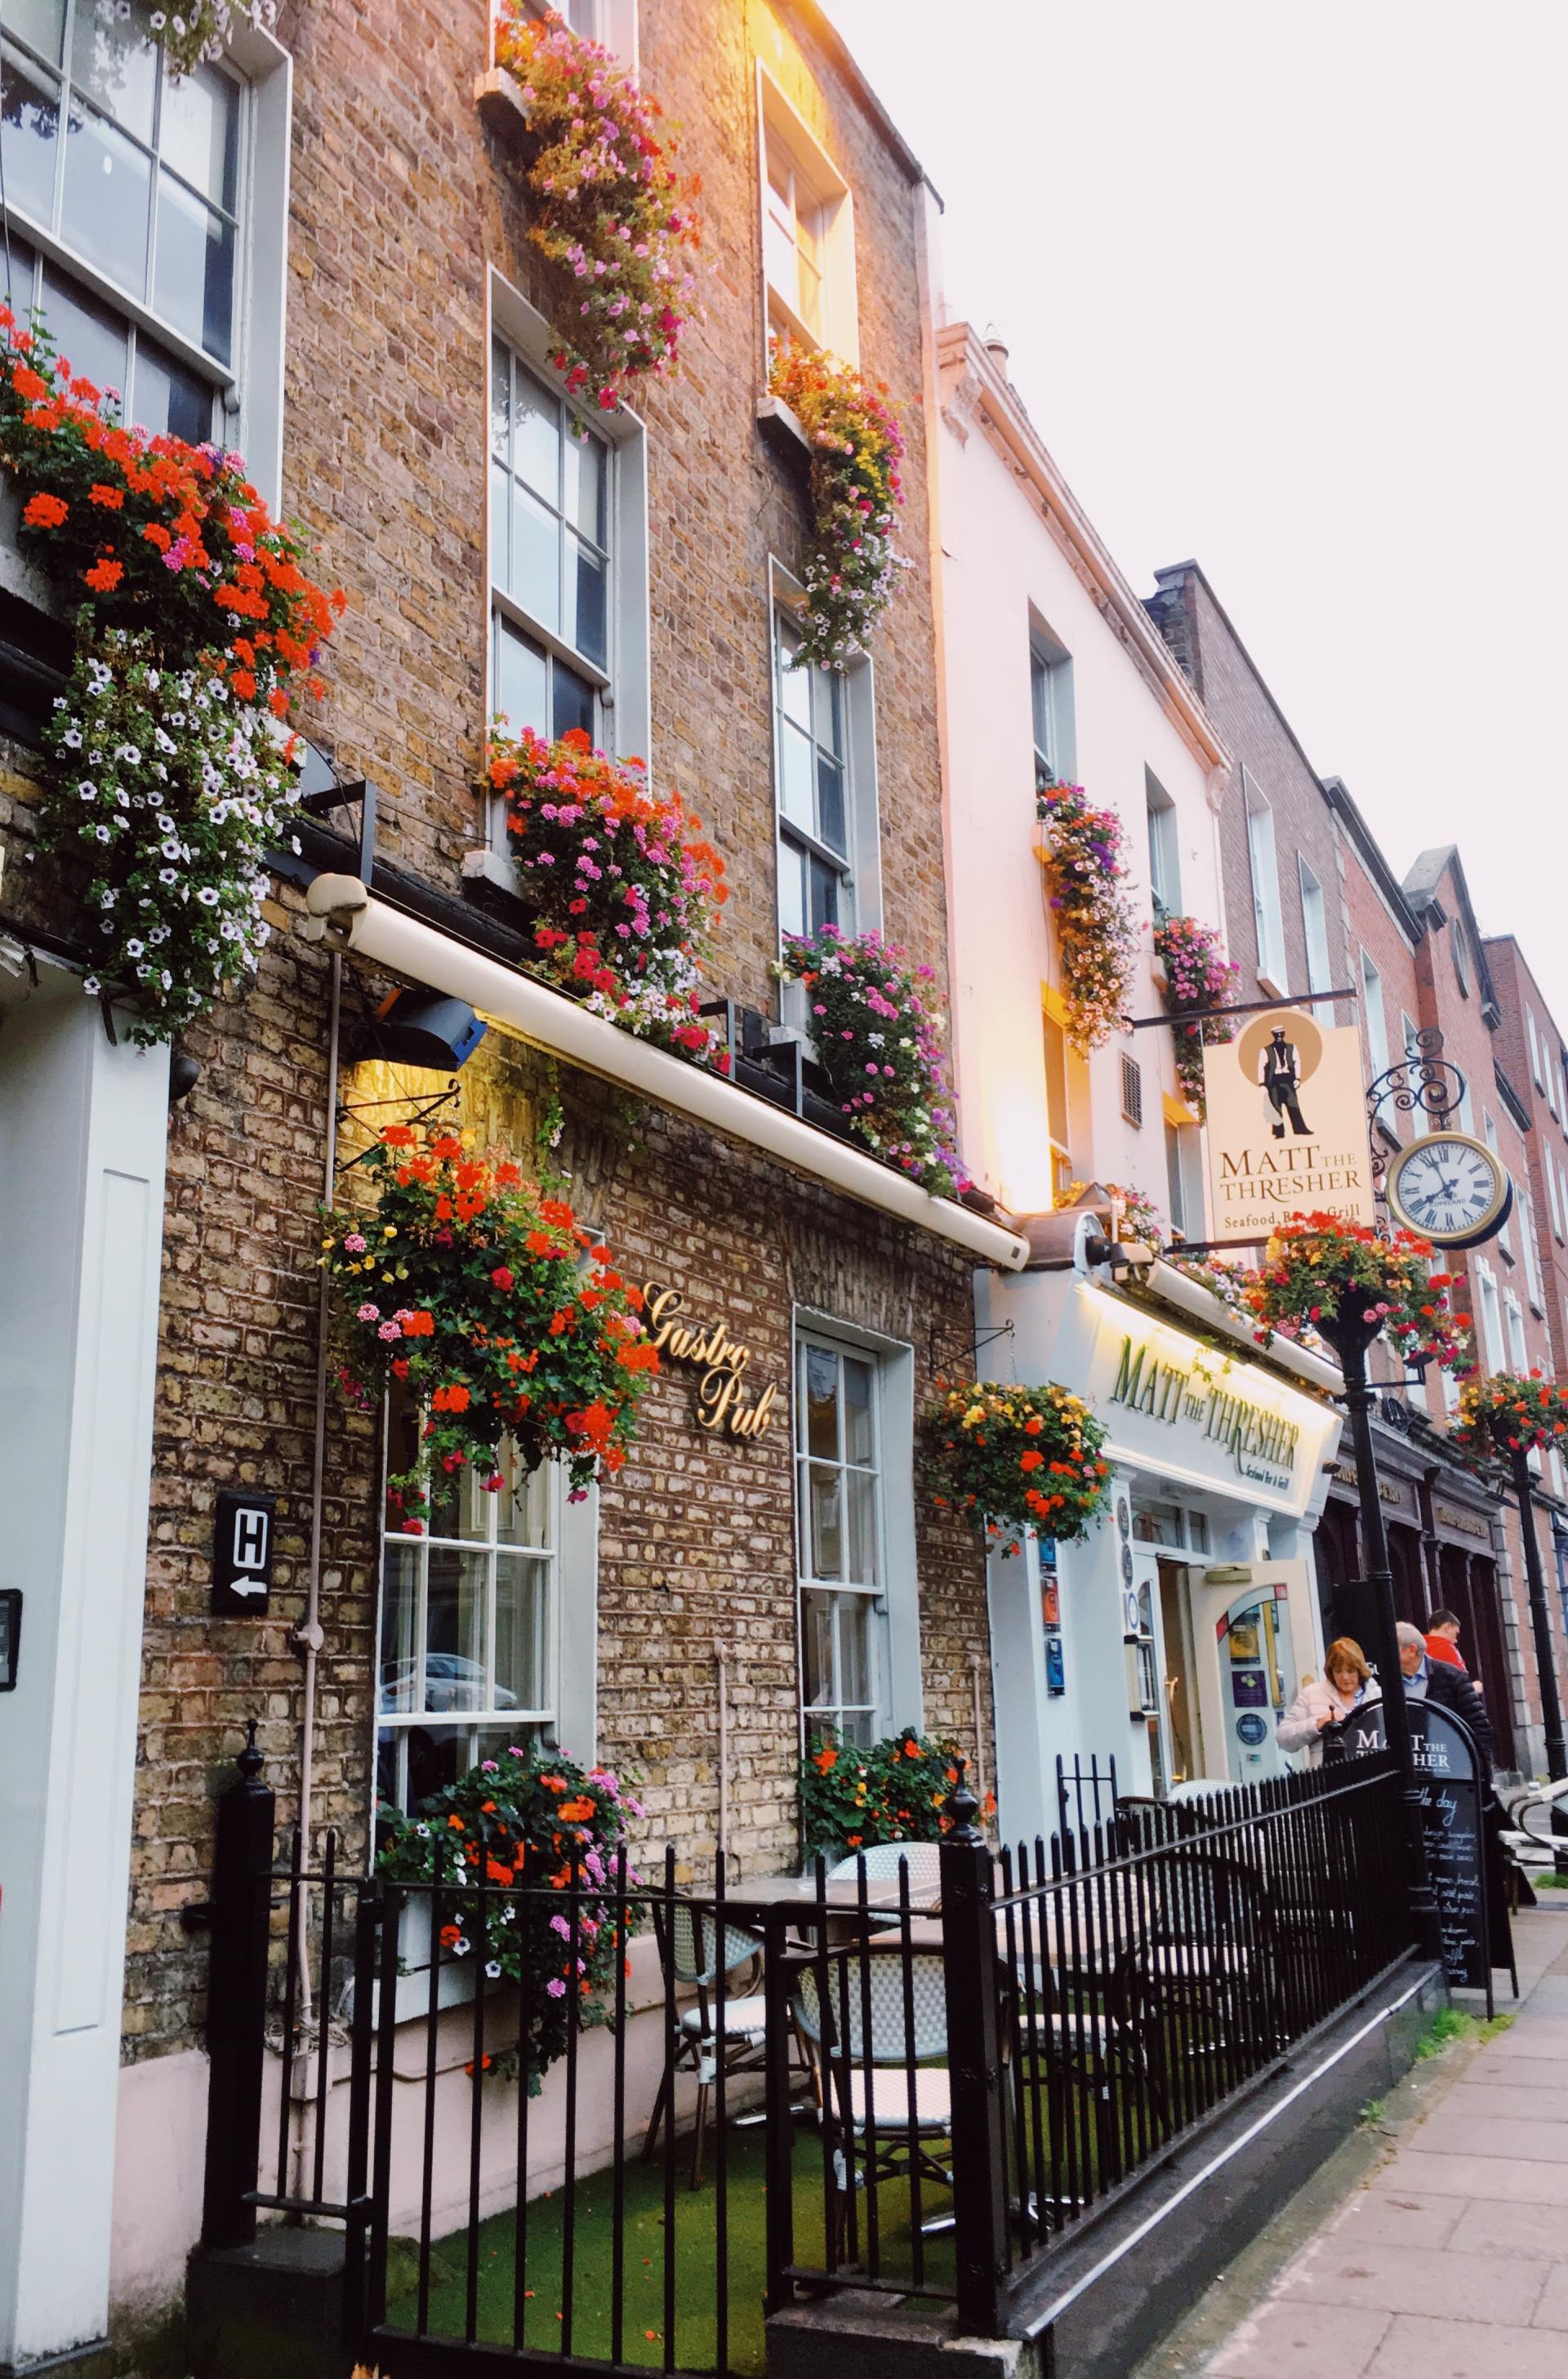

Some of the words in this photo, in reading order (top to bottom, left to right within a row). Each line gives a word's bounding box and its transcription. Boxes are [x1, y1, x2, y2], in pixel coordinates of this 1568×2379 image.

[1219, 1144, 1320, 1179] MATT
[1321, 1153, 1357, 1168] THE
[1219, 1170, 1362, 1202] THRESHER
[1224, 1210, 1281, 1229] Seafood,
[1327, 1203, 1361, 1218] Grill
[639, 1281, 751, 1373] Gastro
[697, 1366, 777, 1438] Pub
[1109, 1334, 1191, 1424] MATT
[1185, 1392, 1206, 1423] THE
[1203, 1384, 1299, 1475] THRESHER
[1356, 1730, 1424, 1752] MT
[1423, 1743, 1448, 1753] THE
[1436, 1788, 1458, 1827] day
